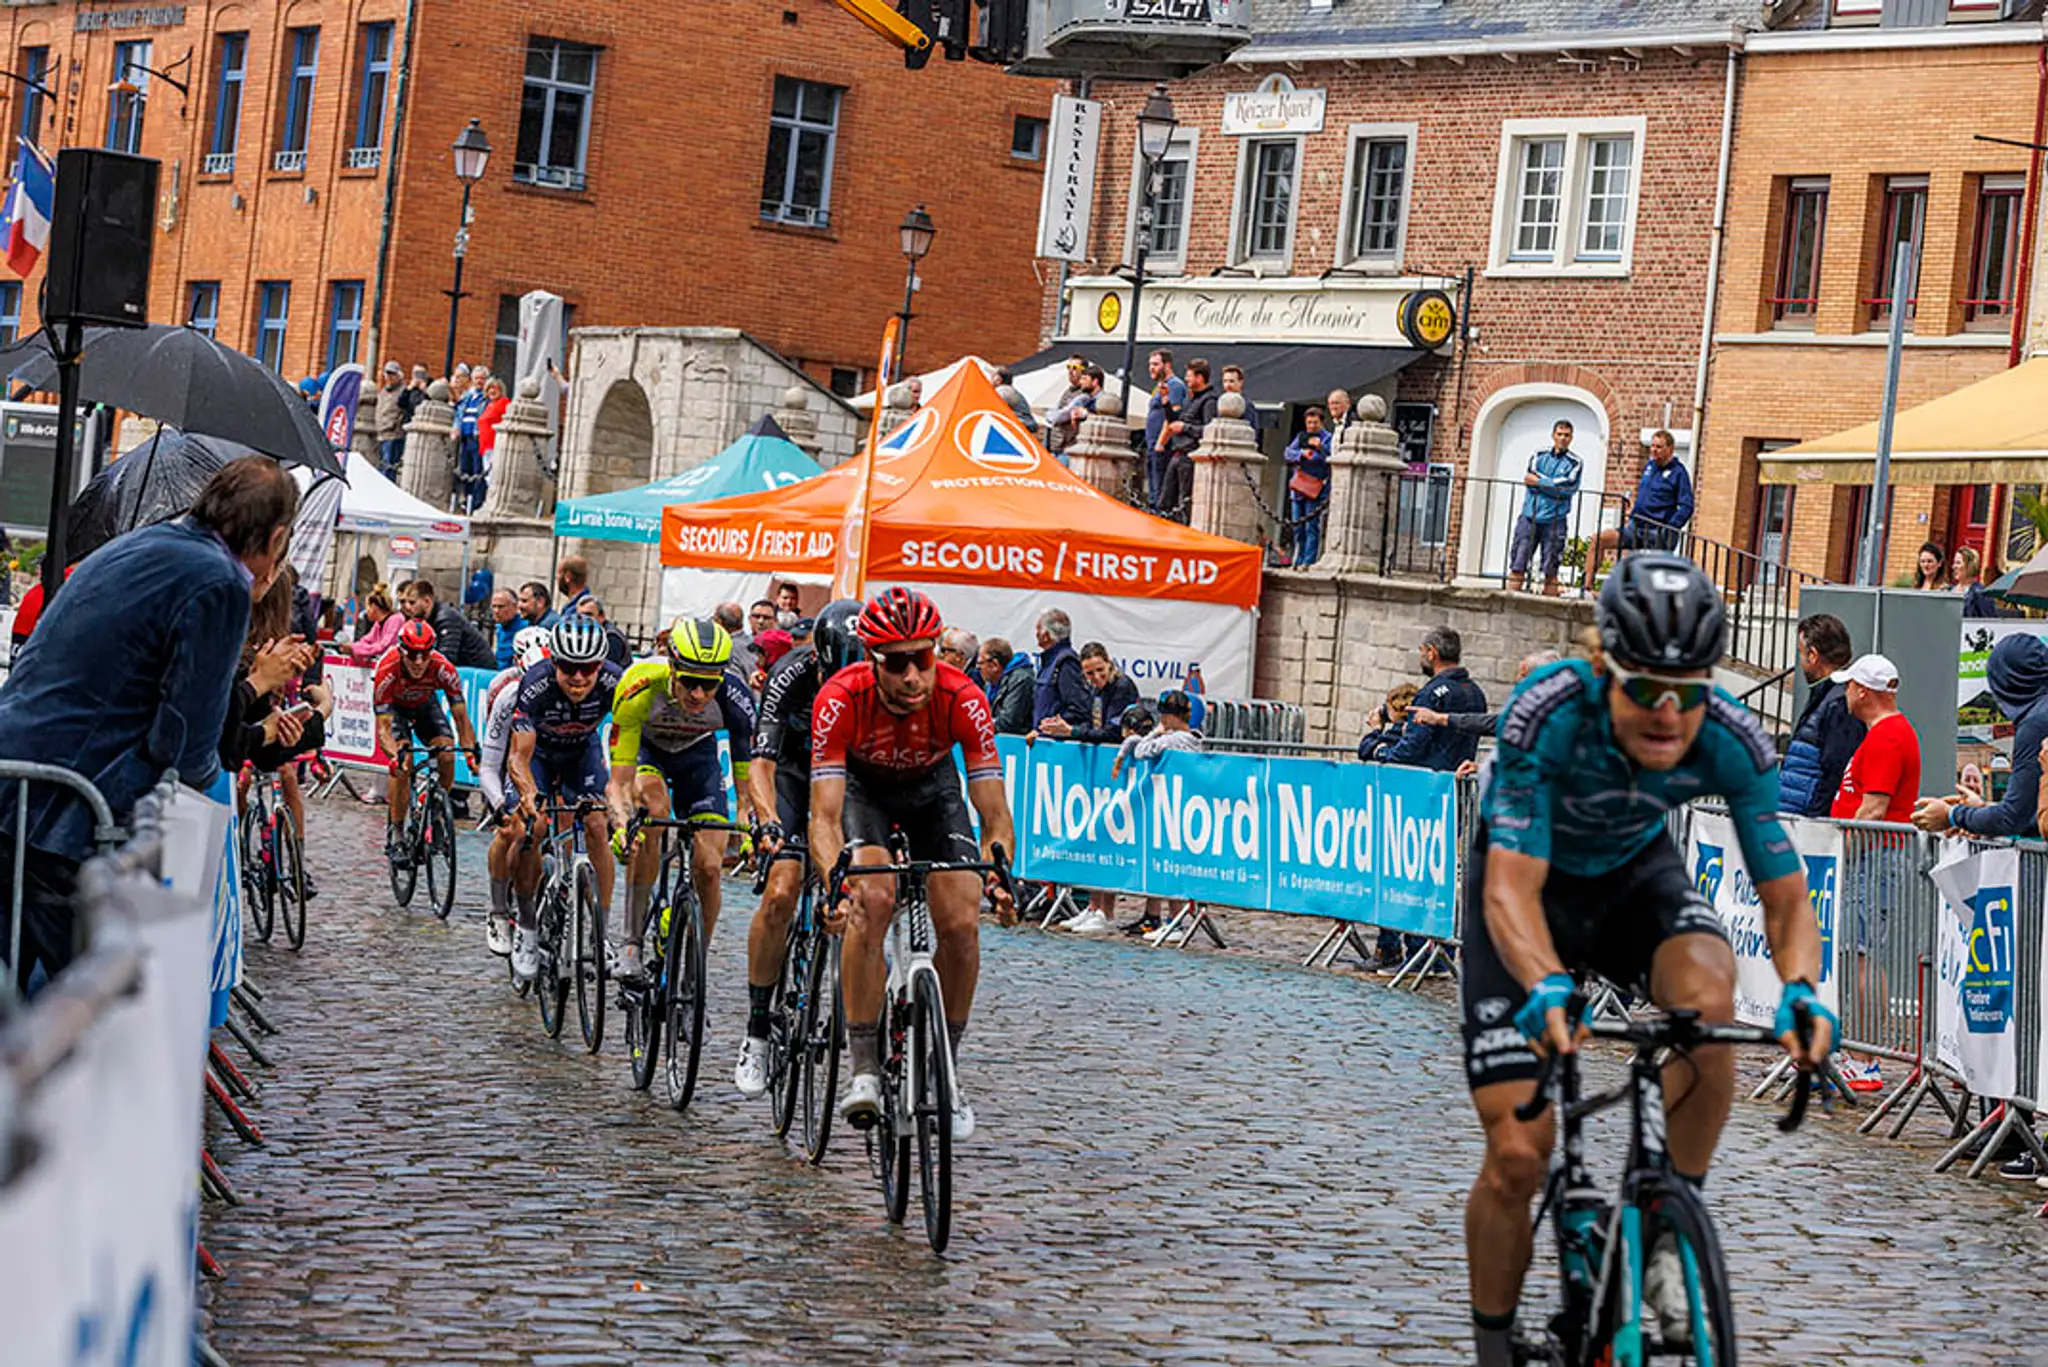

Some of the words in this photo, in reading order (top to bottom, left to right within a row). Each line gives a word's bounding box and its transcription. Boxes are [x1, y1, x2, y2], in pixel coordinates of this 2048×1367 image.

[1063, 103, 1087, 221] RESTAURANT
[1150, 292, 1178, 333] La
[1193, 293, 1247, 328] Table
[1251, 294, 1274, 325] du
[1280, 293, 1367, 329] Meunier
[930, 476, 1044, 490] PROTECTION
[1047, 481, 1100, 498] CIVILE
[679, 525, 749, 556] SECOURS
[761, 529, 805, 556] FIRST
[806, 532, 834, 558] AID
[901, 540, 1044, 575] SECOURS
[1075, 551, 1158, 582] FIRST
[1165, 558, 1219, 585] AID
[961, 699, 997, 761] ARKEA
[1032, 762, 1137, 845] Nord
[1152, 773, 1259, 862] Nord
[1277, 783, 1372, 873] Nord
[1383, 793, 1449, 886] Nord
